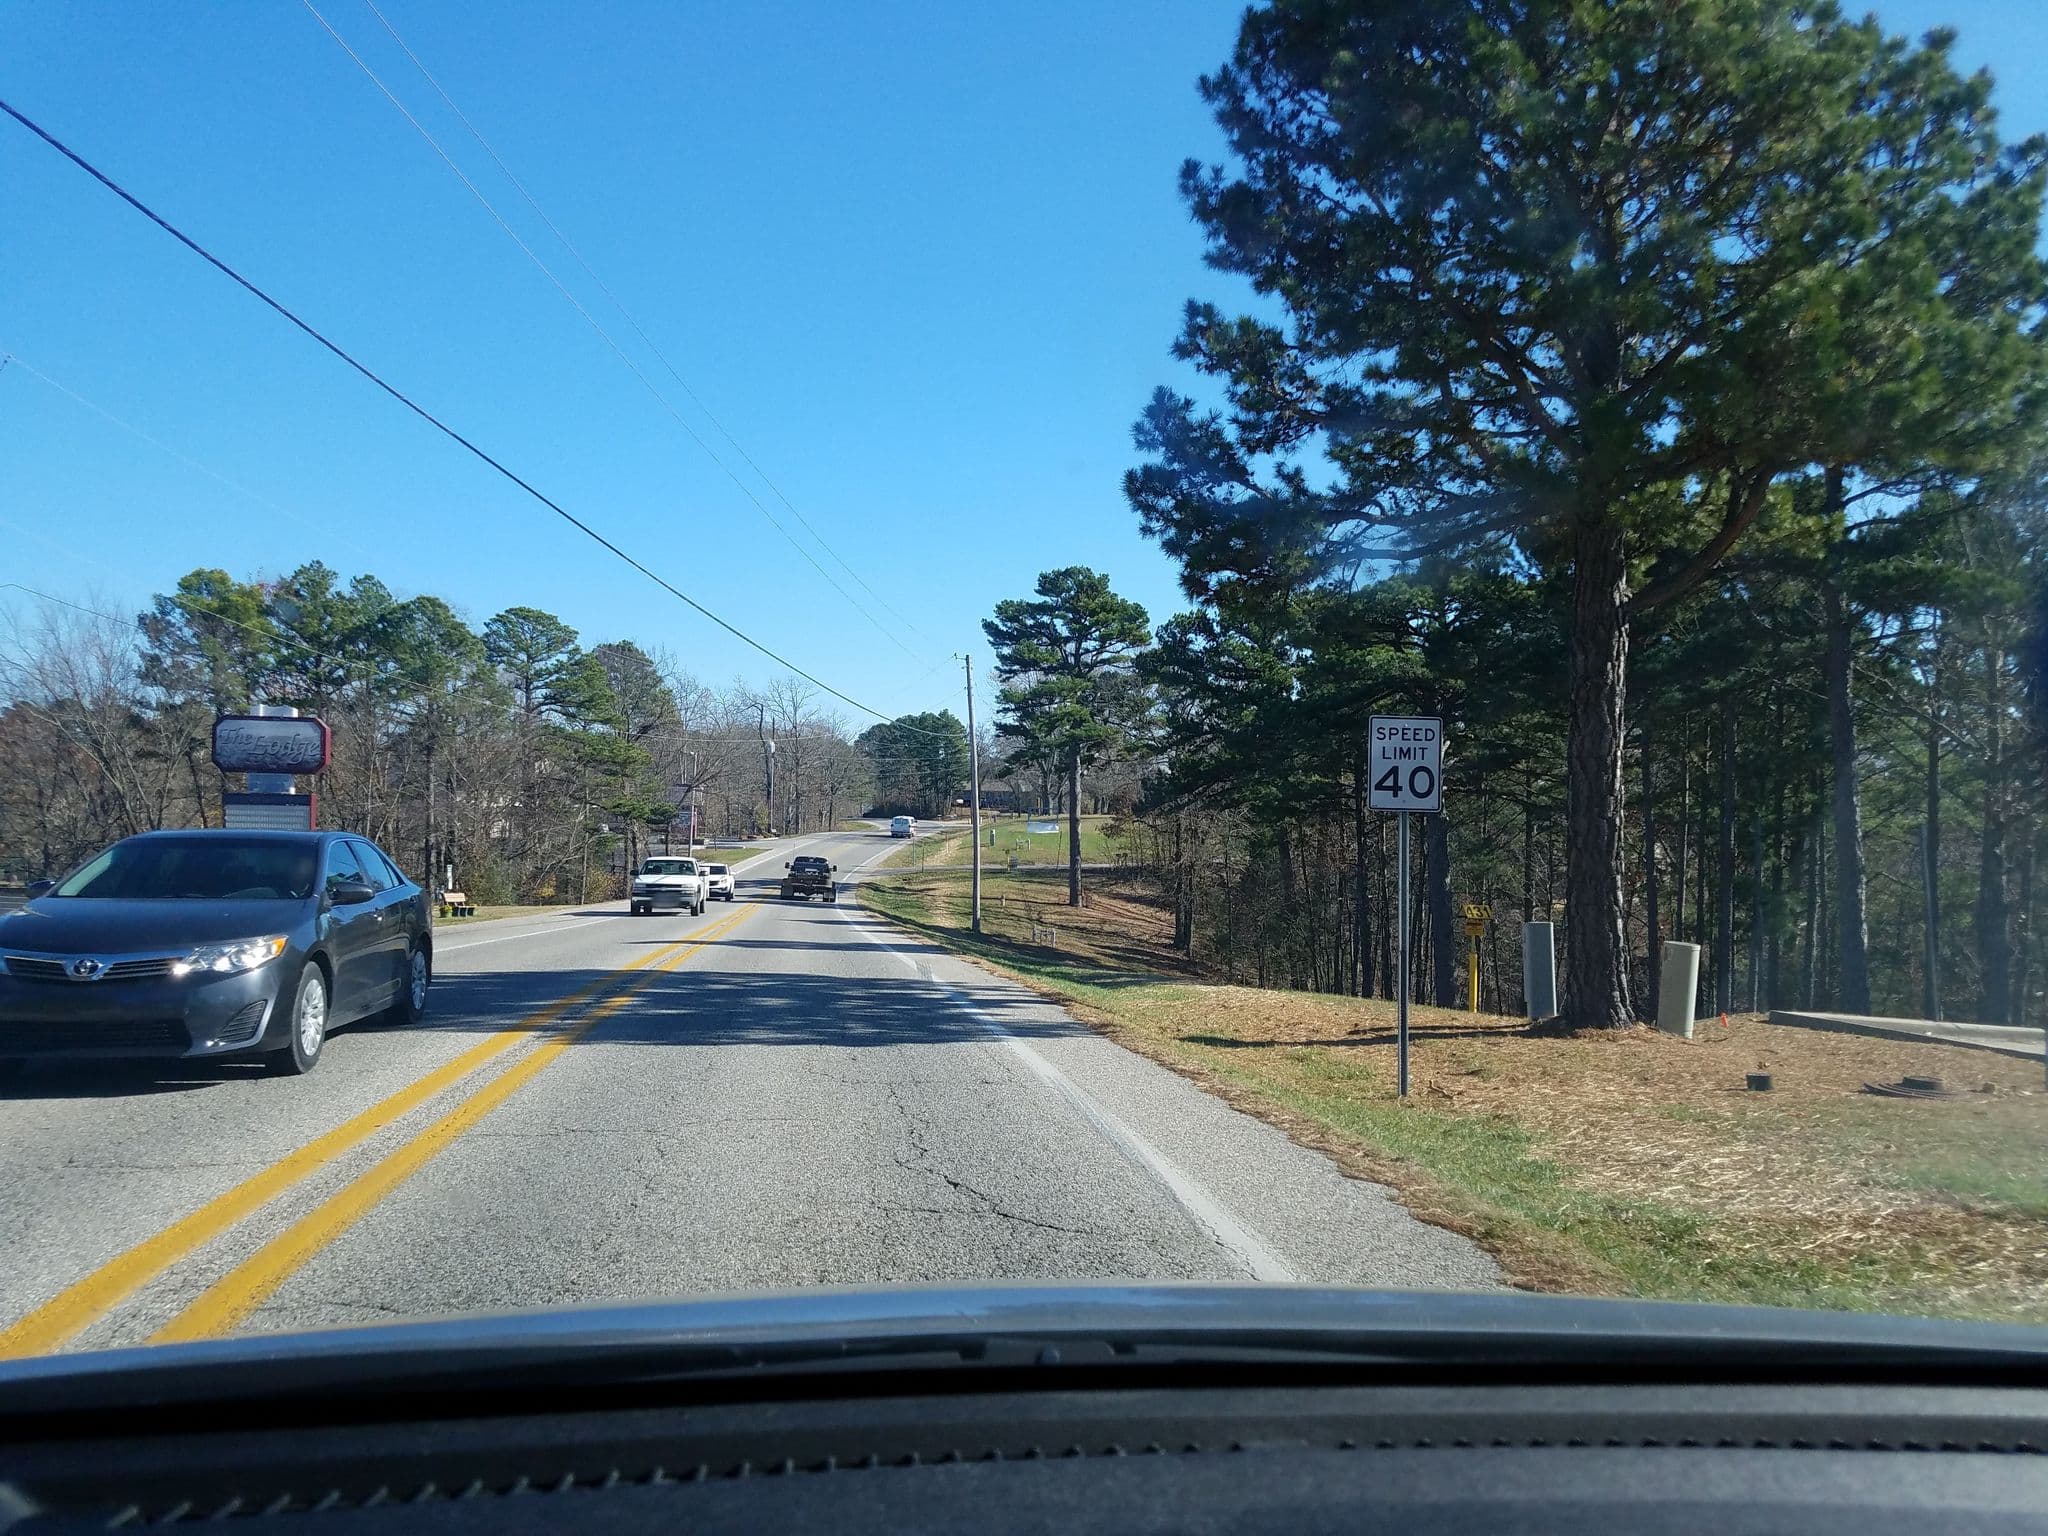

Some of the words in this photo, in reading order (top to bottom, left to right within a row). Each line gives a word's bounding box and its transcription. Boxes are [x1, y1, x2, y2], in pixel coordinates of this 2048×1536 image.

[1376, 726, 1435, 742] SPEED
[218, 727, 253, 745] The
[248, 733, 321, 766] Lodge
[1382, 746, 1428, 761] LIMIT
[1374, 765, 1435, 799] 40
[1466, 903, 1490, 917] 431
